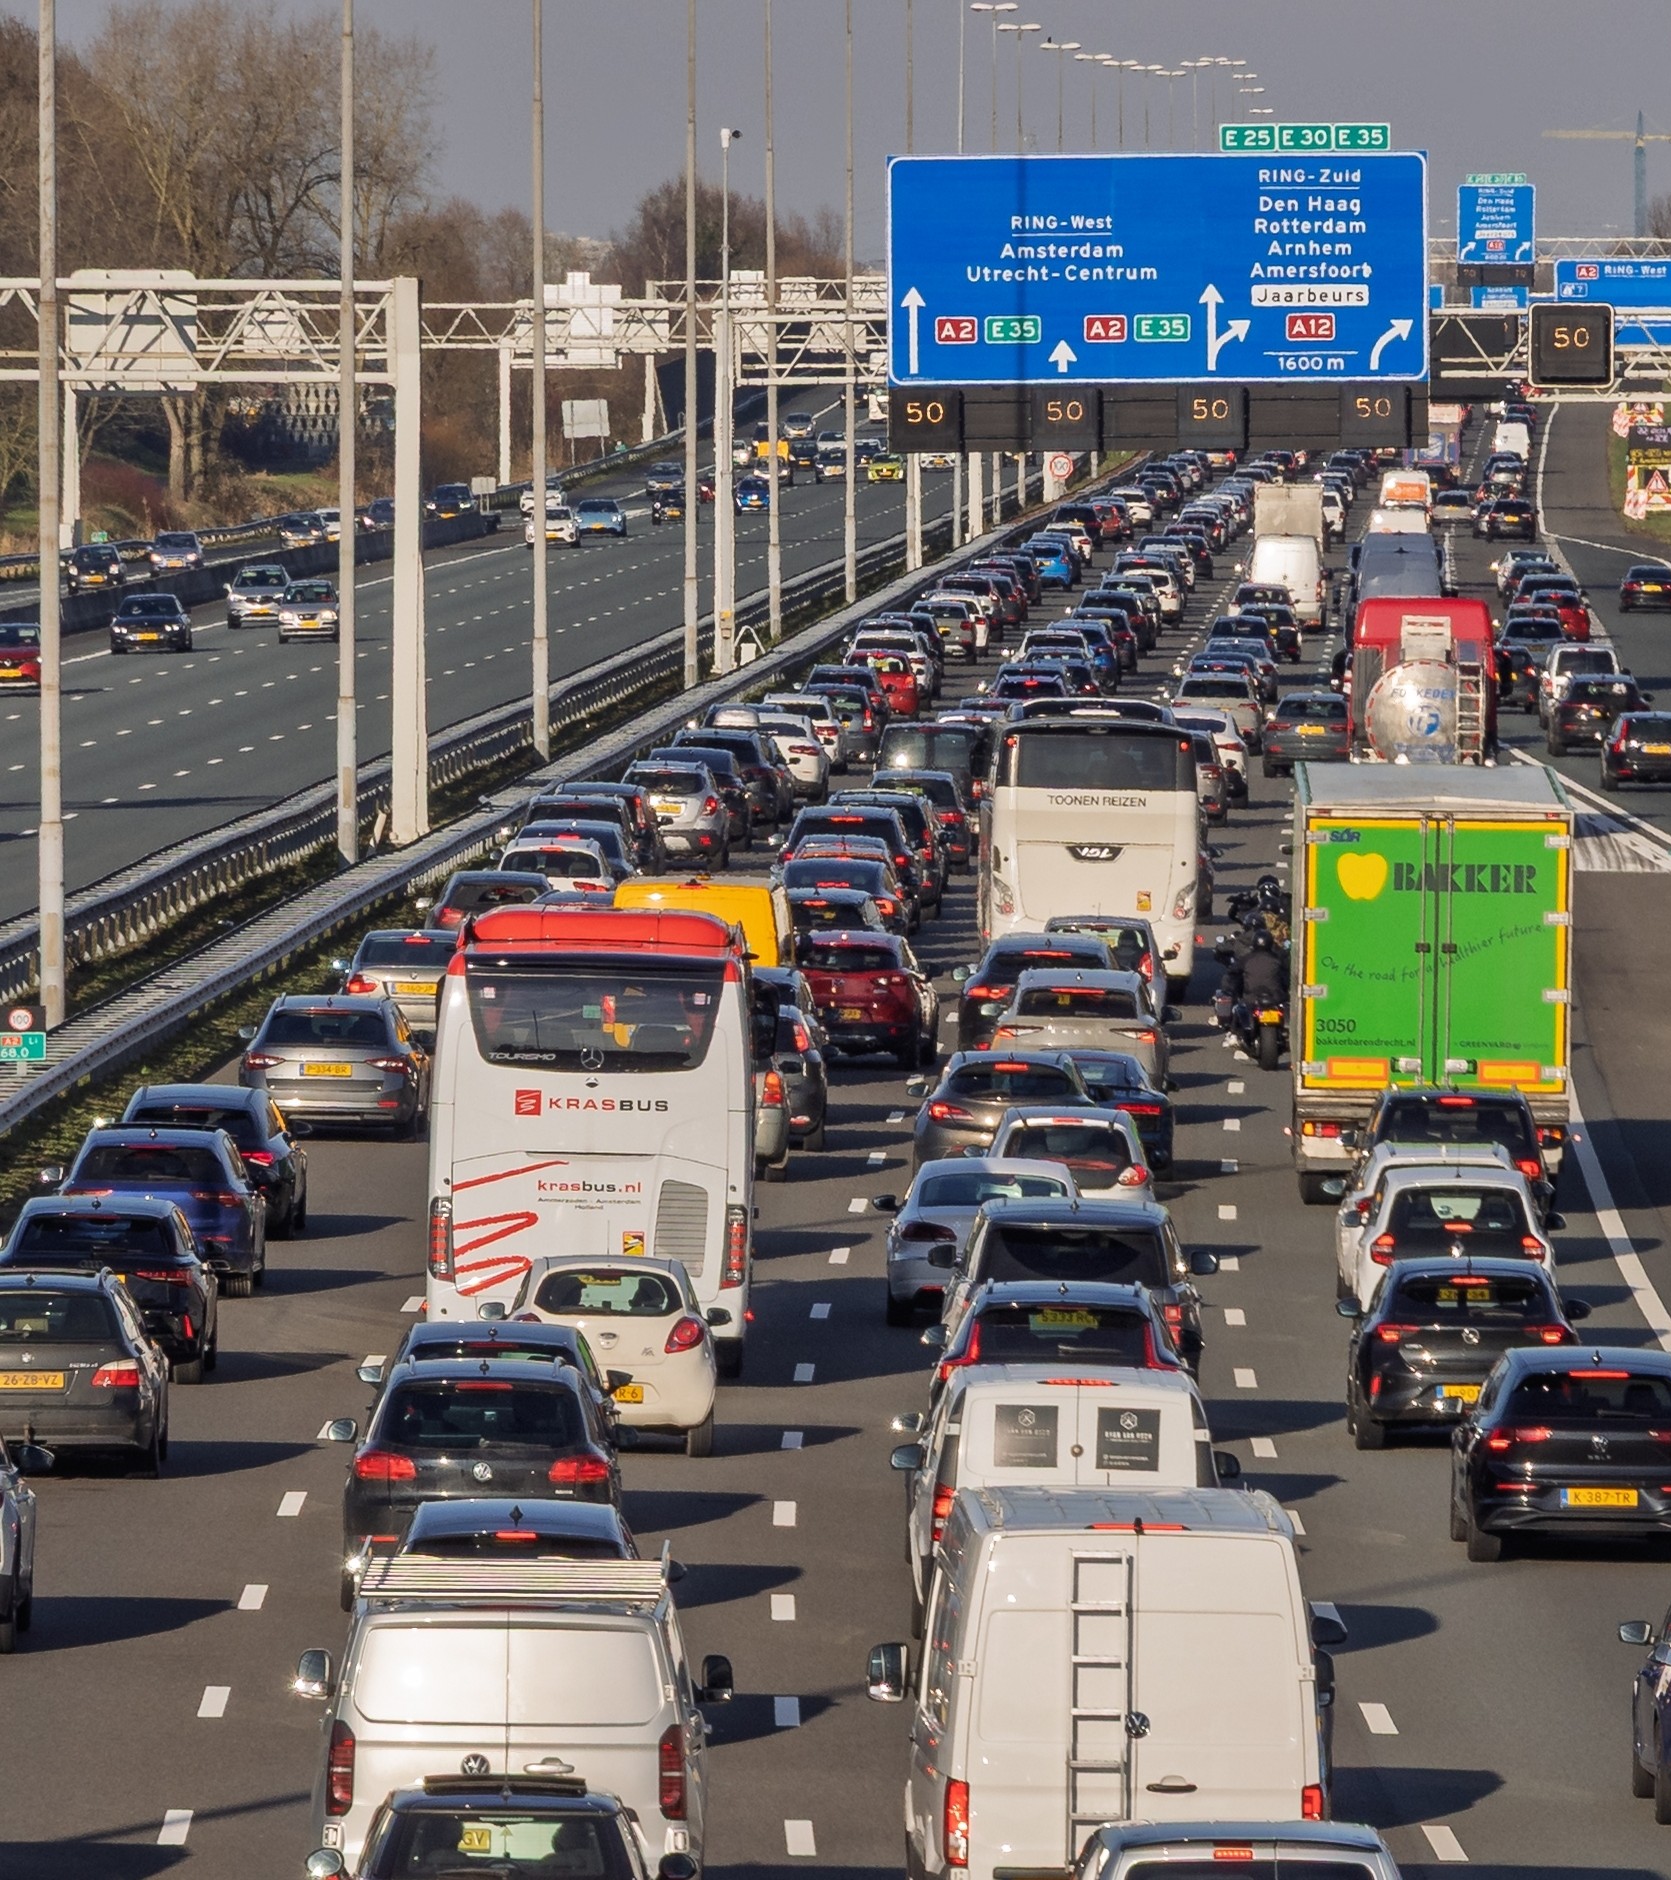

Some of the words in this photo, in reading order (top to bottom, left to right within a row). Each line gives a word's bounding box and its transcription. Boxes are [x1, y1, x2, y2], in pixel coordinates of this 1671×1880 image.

[1225, 130, 1236, 146] E
[1243, 129, 1271, 146] 25
[1282, 130, 1292, 146] E
[1299, 129, 1328, 146] 30
[1339, 130, 1349, 146] E
[1356, 129, 1384, 146] 35
[1259, 168, 1361, 184] RING-Zuid
[1259, 196, 1298, 213] Den
[1308, 196, 1361, 216] Haag
[1011, 214, 1113, 230] RING-West
[1254, 217, 1366, 234] Rotterdam
[1000, 242, 1124, 259] Amsterdam
[1268, 239, 1352, 256] Arnhem
[967, 264, 1158, 282] Utrecht-Centrum
[1250, 261, 1372, 278] Amersfoort
[1578, 265, 1598, 278] A2
[1257, 287, 1365, 304] Jaarbeurs
[939, 320, 974, 339] A2
[1006, 321, 1036, 339] 35
[1088, 319, 1123, 338] A2
[1156, 319, 1186, 337] 35
[1290, 316, 1331, 336] A12
[1554, 328, 1589, 348] 50
[1278, 355, 1323, 371] 1600
[1326, 358, 1345, 371] m
[906, 402, 944, 423] 50
[1046, 401, 1083, 421] 50
[1192, 399, 1229, 420] 50
[1355, 397, 1391, 418] 50
[1047, 794, 1100, 806] TOONEN
[1102, 795, 1147, 808] REIZEN
[1393, 862, 1537, 894] BAKKER
[1321, 955, 1339, 972] On
[1344, 963, 1363, 979] the
[1369, 966, 1395, 982] road
[1316, 1018, 1357, 1033] 3050
[489, 1052, 557, 1062] TOURISMO
[549, 1097, 669, 1112] KRASBUS
[538, 1179, 642, 1194] krasbus.nl
[1573, 1491, 1631, 1504] K-387-TR
